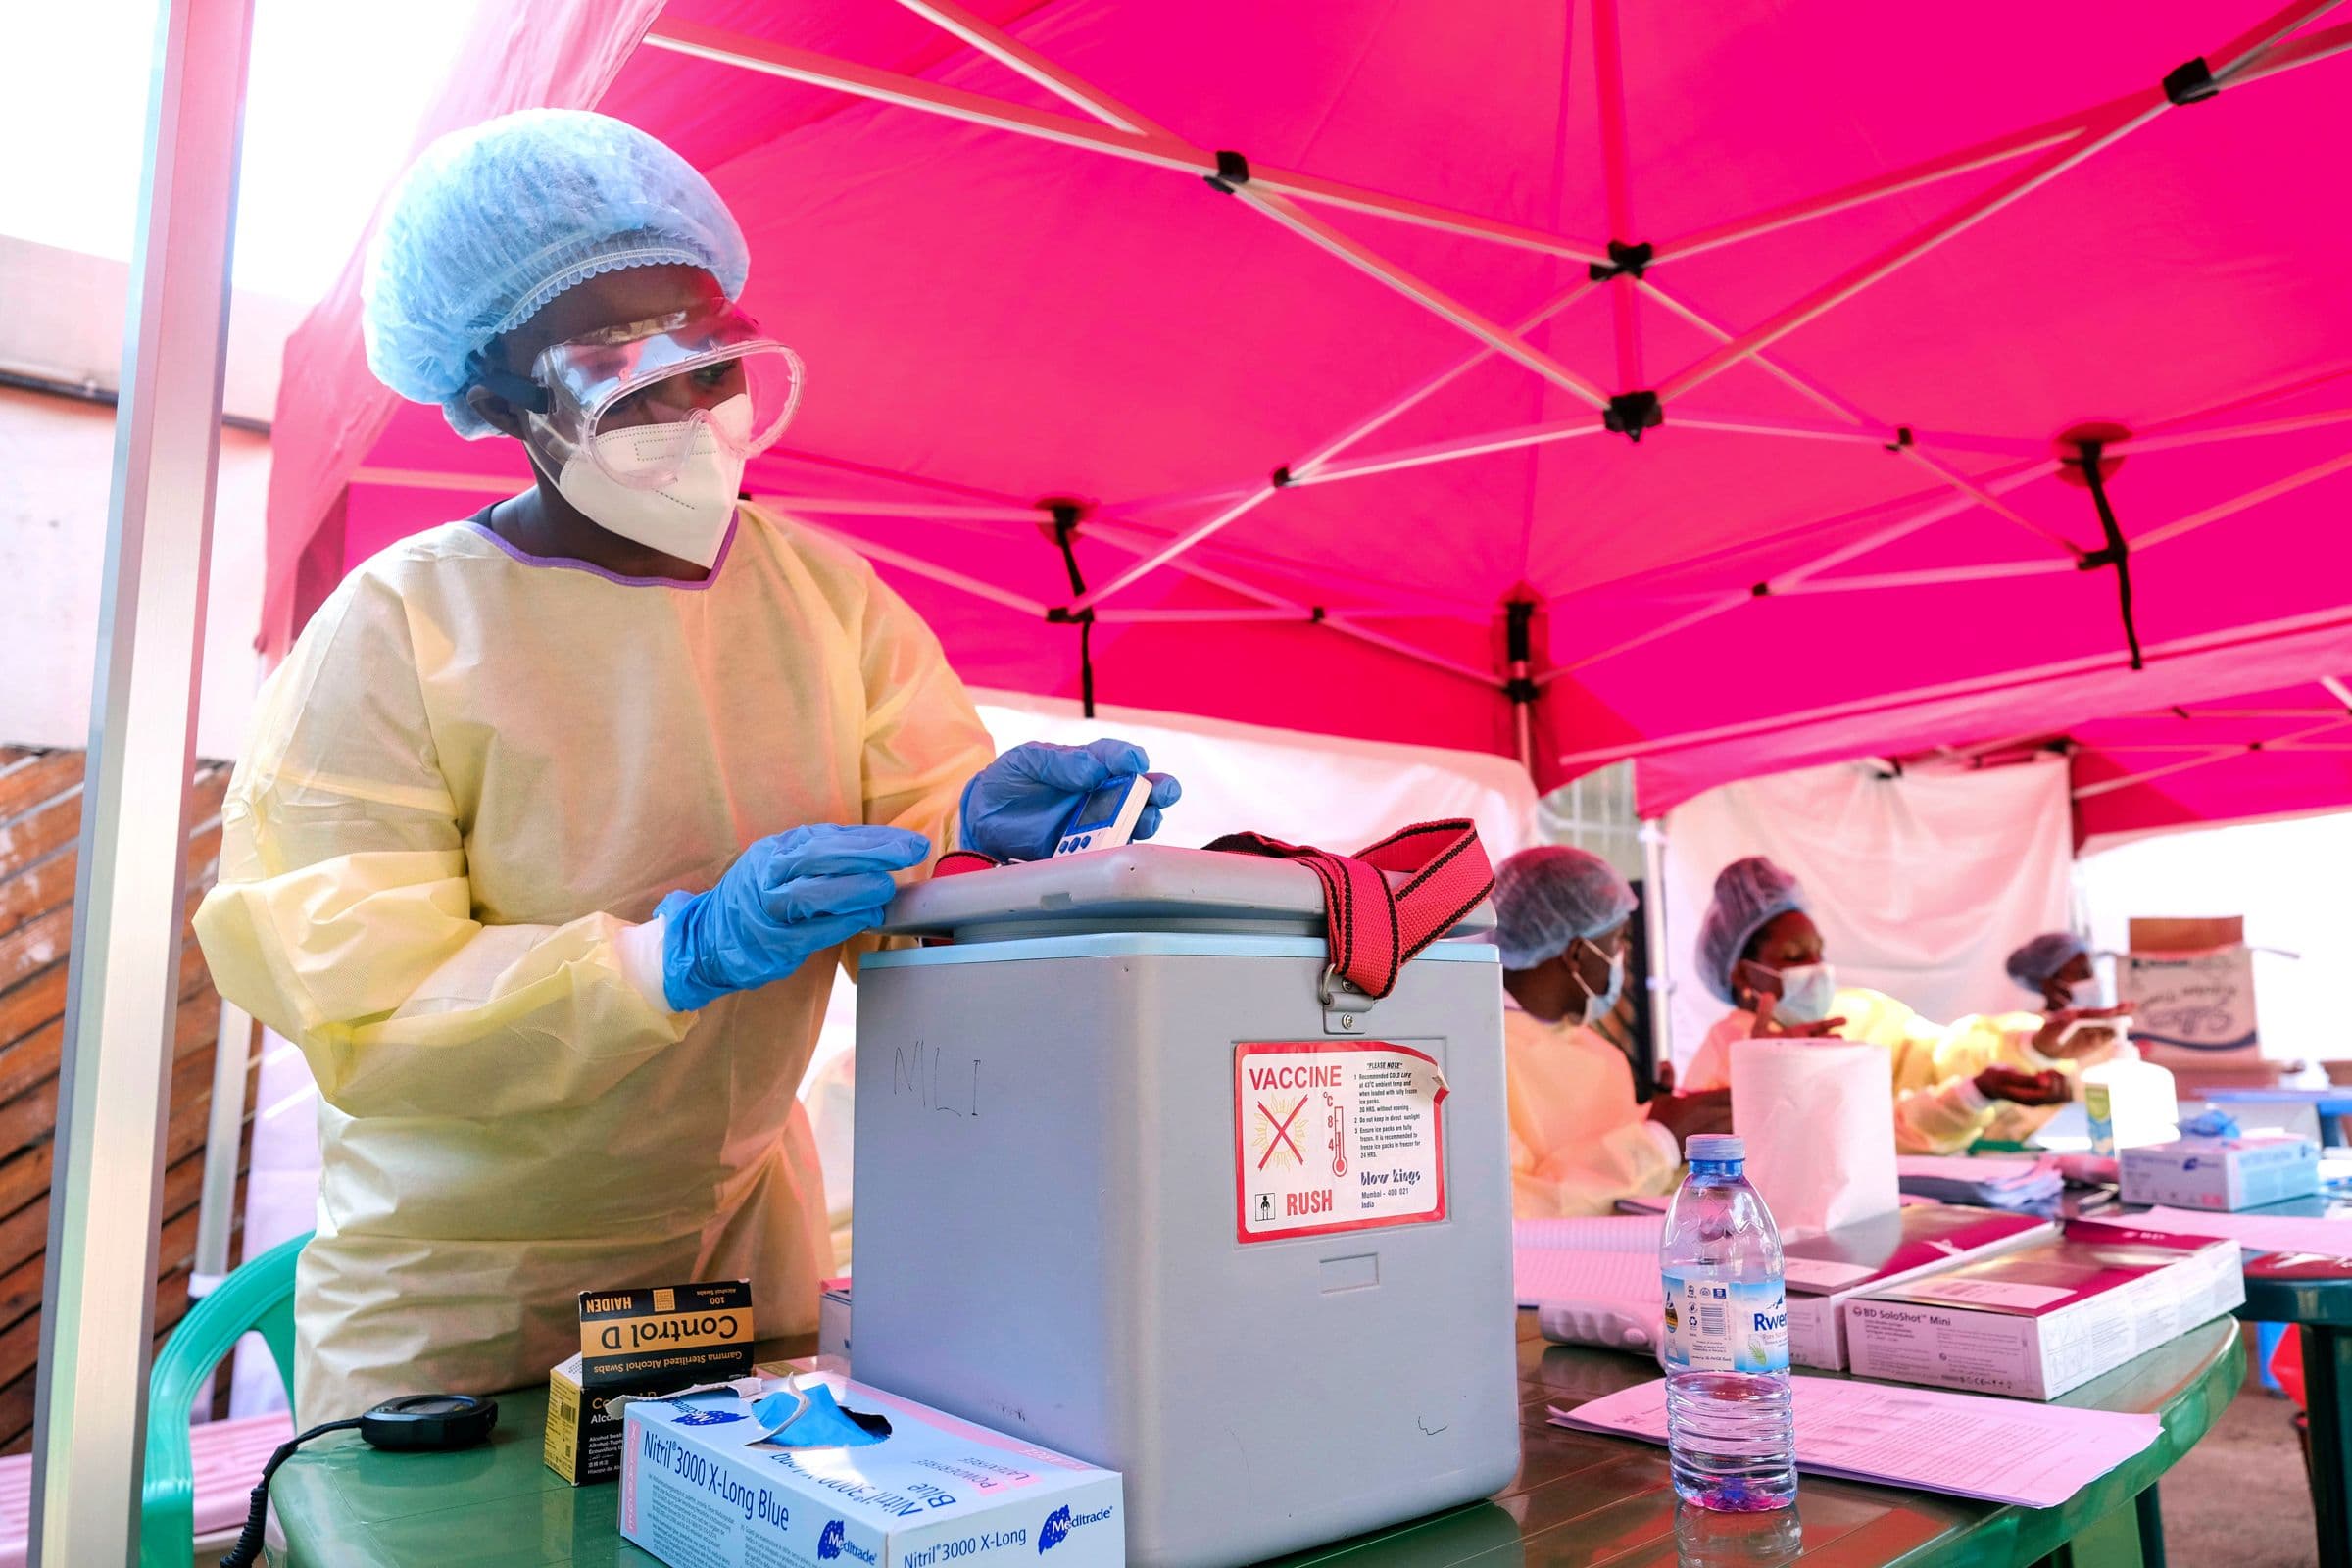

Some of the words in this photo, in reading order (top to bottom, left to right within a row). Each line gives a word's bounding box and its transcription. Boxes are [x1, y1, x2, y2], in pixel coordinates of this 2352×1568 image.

[1249, 1065, 1343, 1091] VACCINE
[1327, 1115, 1334, 1128] 8
[1328, 1138, 1335, 1152] 4
[1360, 1170, 1389, 1186] blow
[1392, 1168, 1421, 1186] kings
[1286, 1189, 1334, 1217] RUSH
[1361, 1190, 1382, 1199] Mumbai
[1361, 1200, 1375, 1209] India
[586, 1296, 633, 1314] HAIDEN
[710, 1297, 725, 1305] 100
[1863, 1307, 1878, 1319] BD
[1929, 1316, 1951, 1326] Mini
[601, 1326, 622, 1350] D
[632, 1315, 738, 1348] Control
[663, 1353, 707, 1368] Sterilized
[708, 1350, 743, 1361] Gamma
[593, 1362, 624, 1374] Swabs
[626, 1358, 662, 1372] Alcohol
[708, 1462, 755, 1521] X-Long
[758, 1488, 790, 1531] Blue
[907, 1482, 957, 1510] Blue
[980, 1528, 1027, 1551] X-Long
